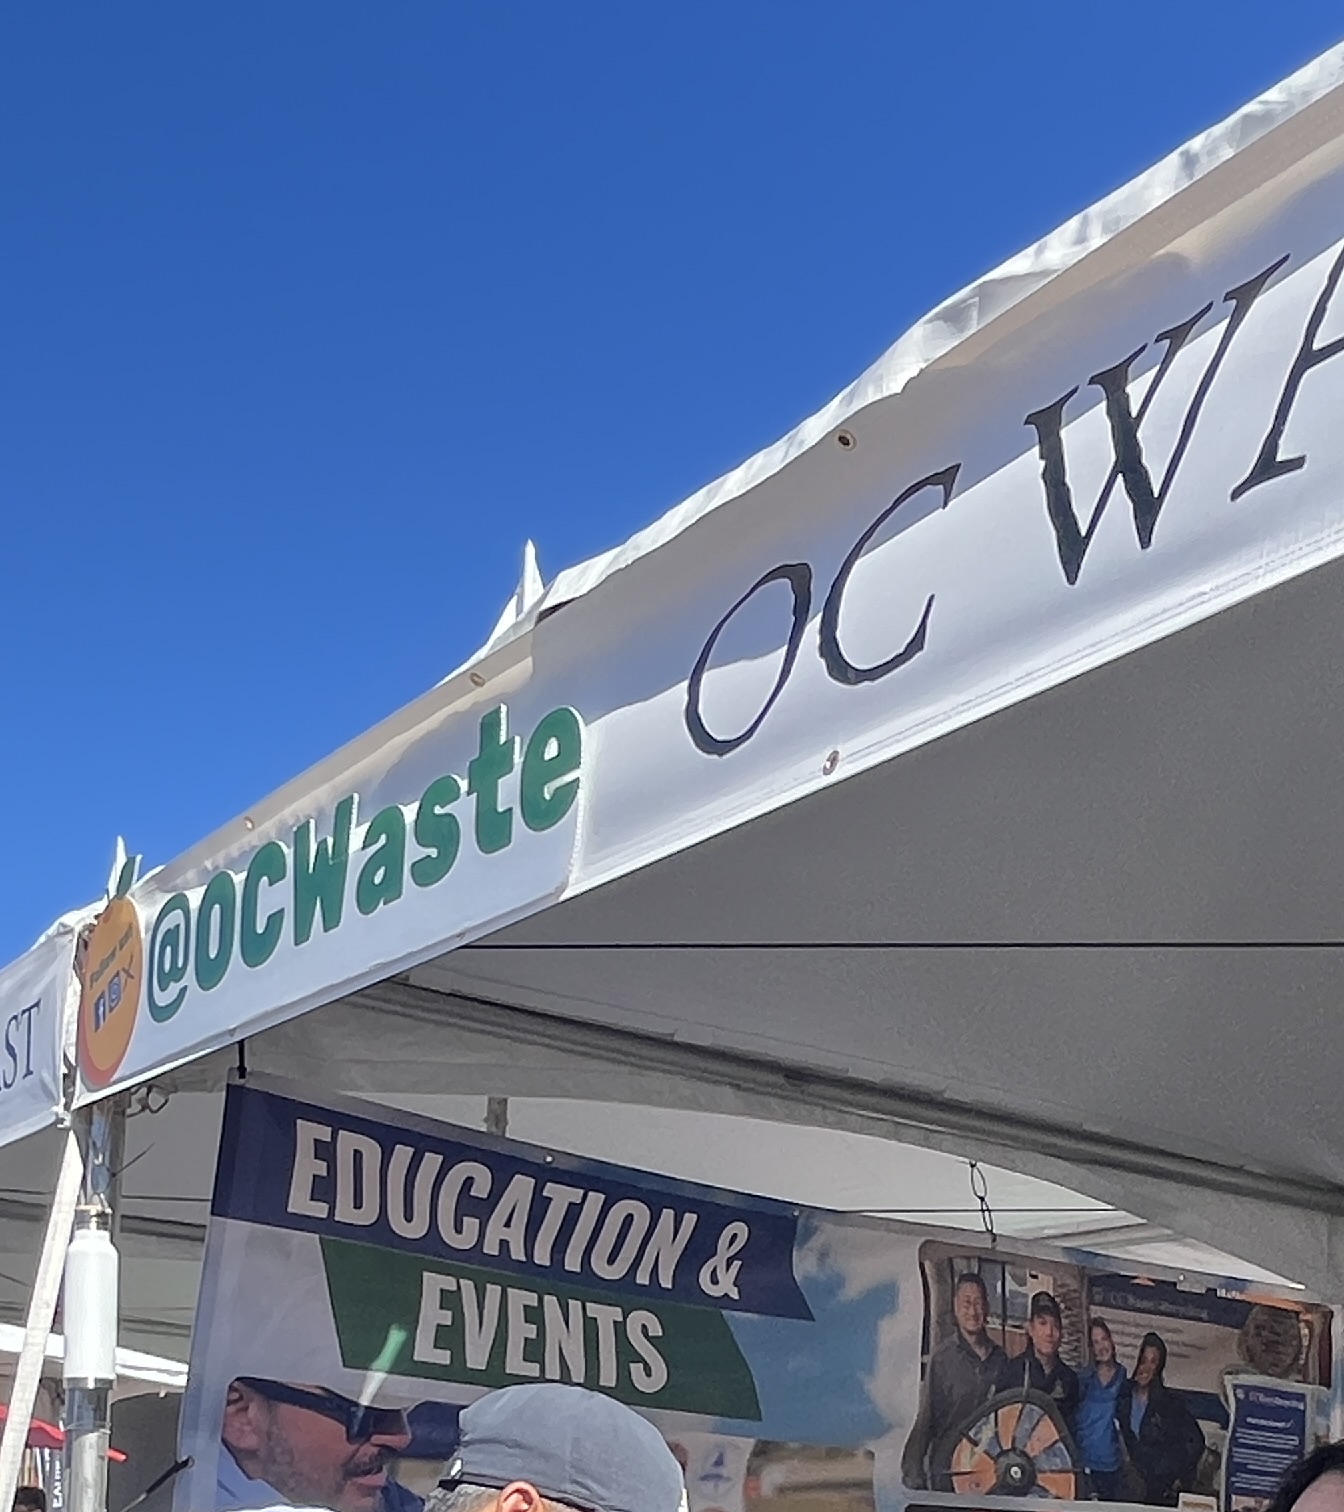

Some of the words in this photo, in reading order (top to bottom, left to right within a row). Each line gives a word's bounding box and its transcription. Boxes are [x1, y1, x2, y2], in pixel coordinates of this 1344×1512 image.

[684, 463, 961, 757] OC
[146, 702, 584, 1024] @OCWaste
[286, 1117, 698, 1289] EDUCATION
[698, 1219, 750, 1300] &
[412, 1270, 669, 1394] EVENTS
